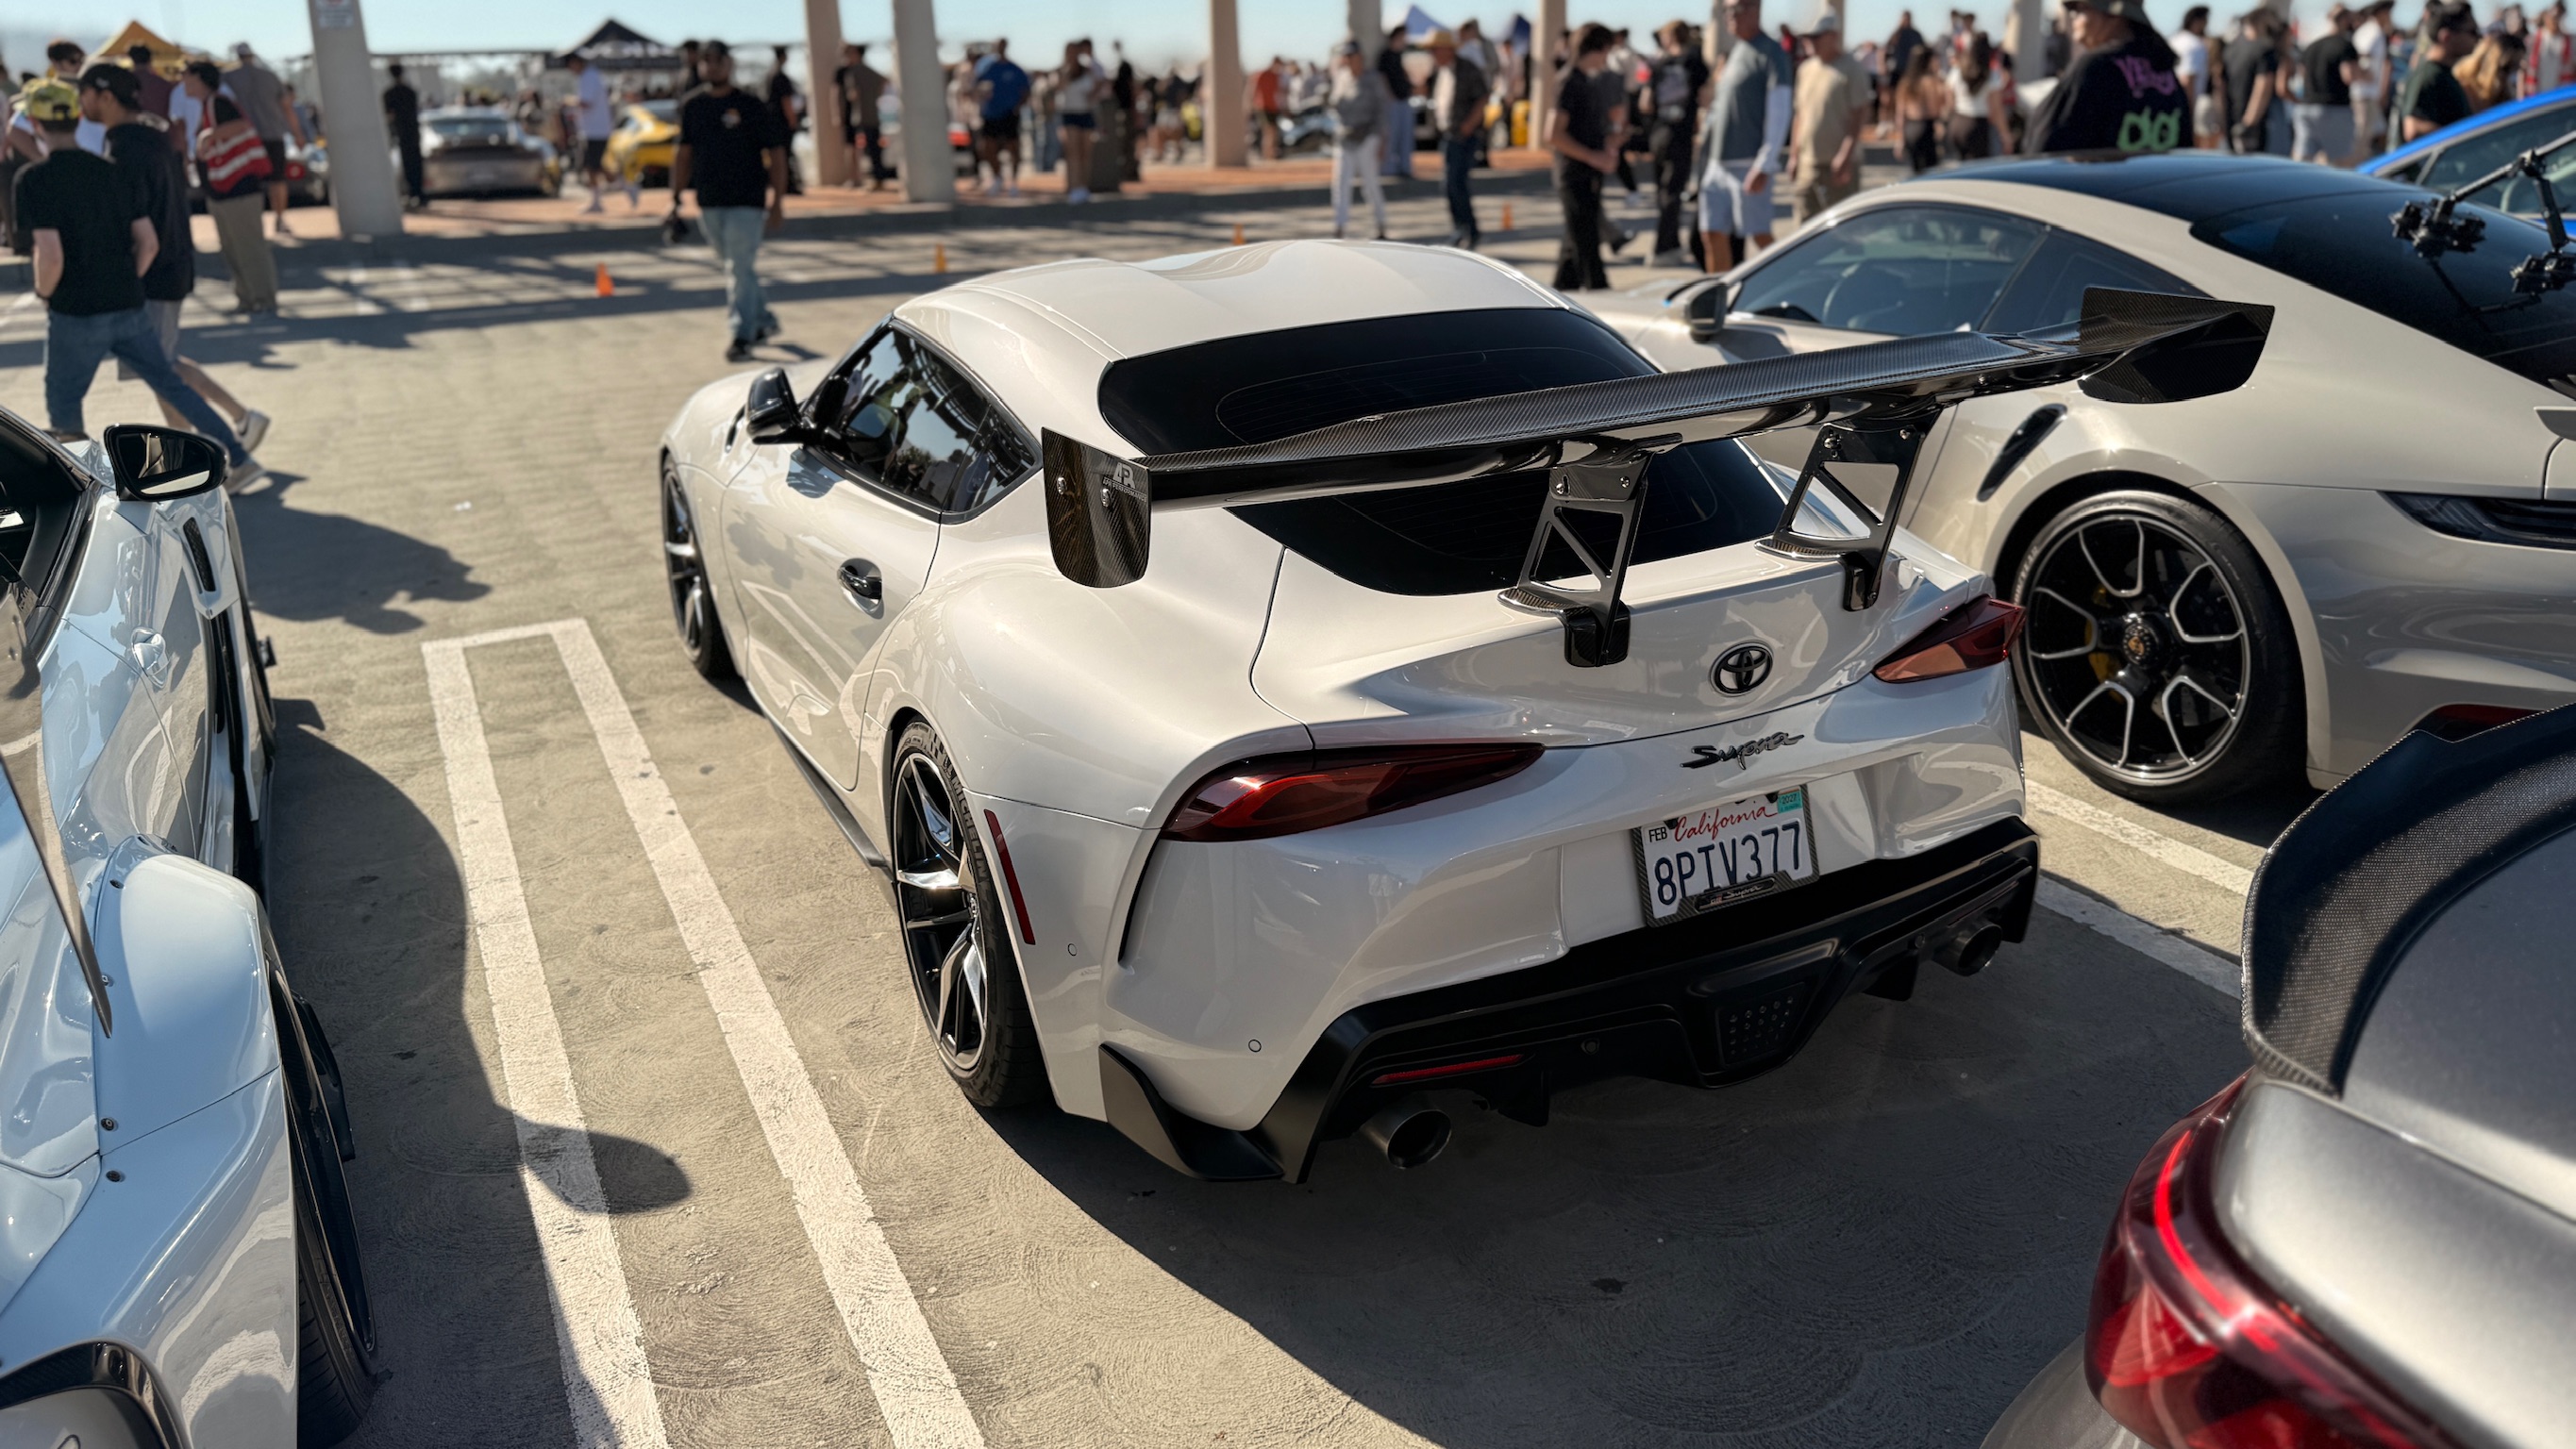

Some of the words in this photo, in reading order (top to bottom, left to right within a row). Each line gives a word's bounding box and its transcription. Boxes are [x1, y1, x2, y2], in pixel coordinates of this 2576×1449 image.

[1680, 732, 1804, 770] Supra
[1781, 793, 1798, 804] 2027
[951, 777, 989, 883] MICHELIN
[1648, 826, 1667, 842] FEB
[1674, 808, 1778, 842] California
[1654, 821, 1800, 906] 8PIV377
[1723, 886, 1764, 899] Supra
